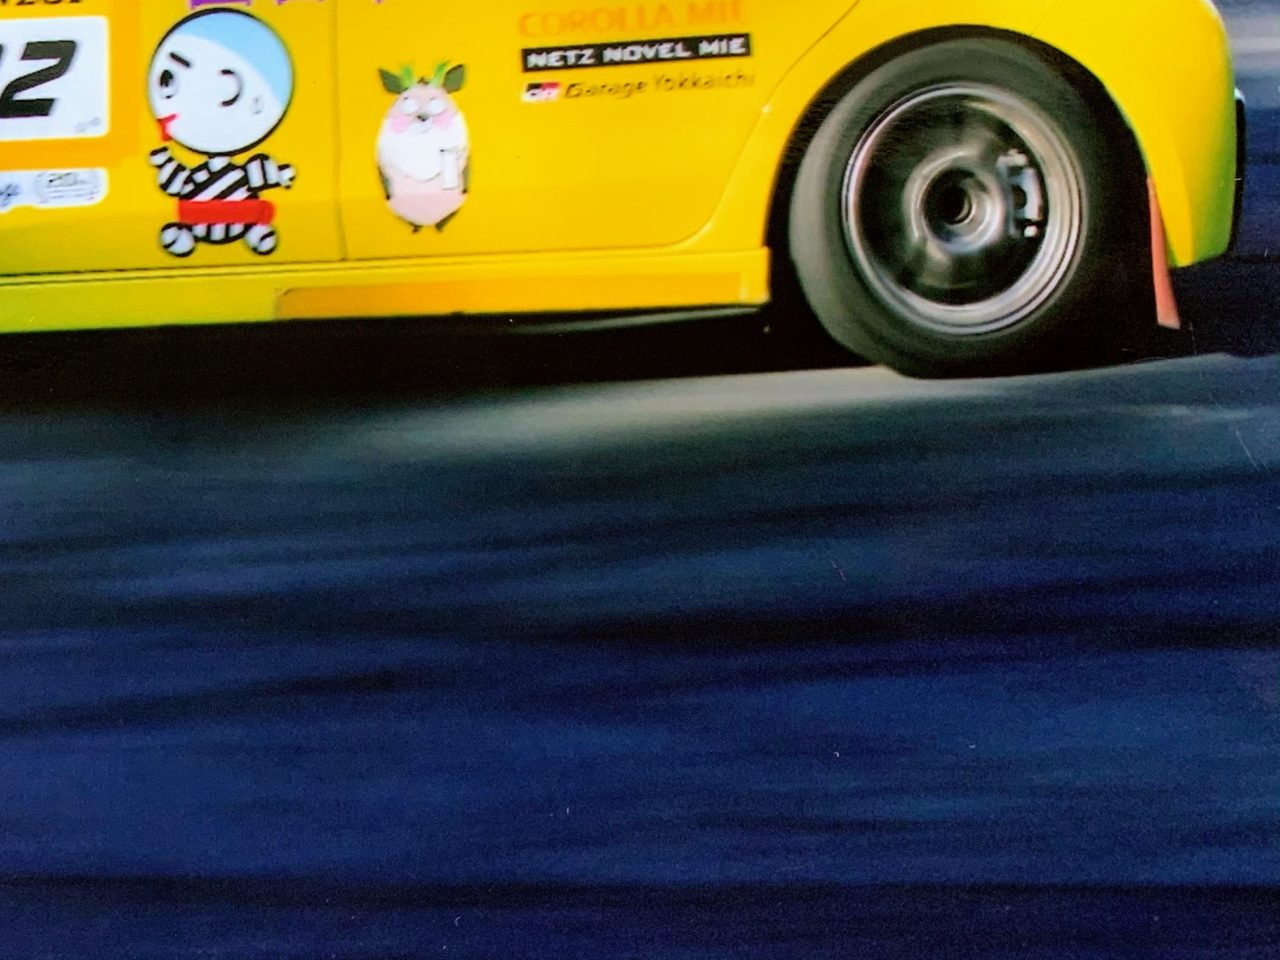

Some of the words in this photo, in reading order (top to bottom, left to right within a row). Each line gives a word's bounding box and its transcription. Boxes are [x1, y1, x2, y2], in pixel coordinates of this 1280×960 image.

[519, 3, 677, 38] COROLLA
[527, 48, 595, 68] NETZ
[603, 42, 693, 63] NOVEL
[698, 37, 747, 56] MIE
[565, 81, 647, 100] Garage
